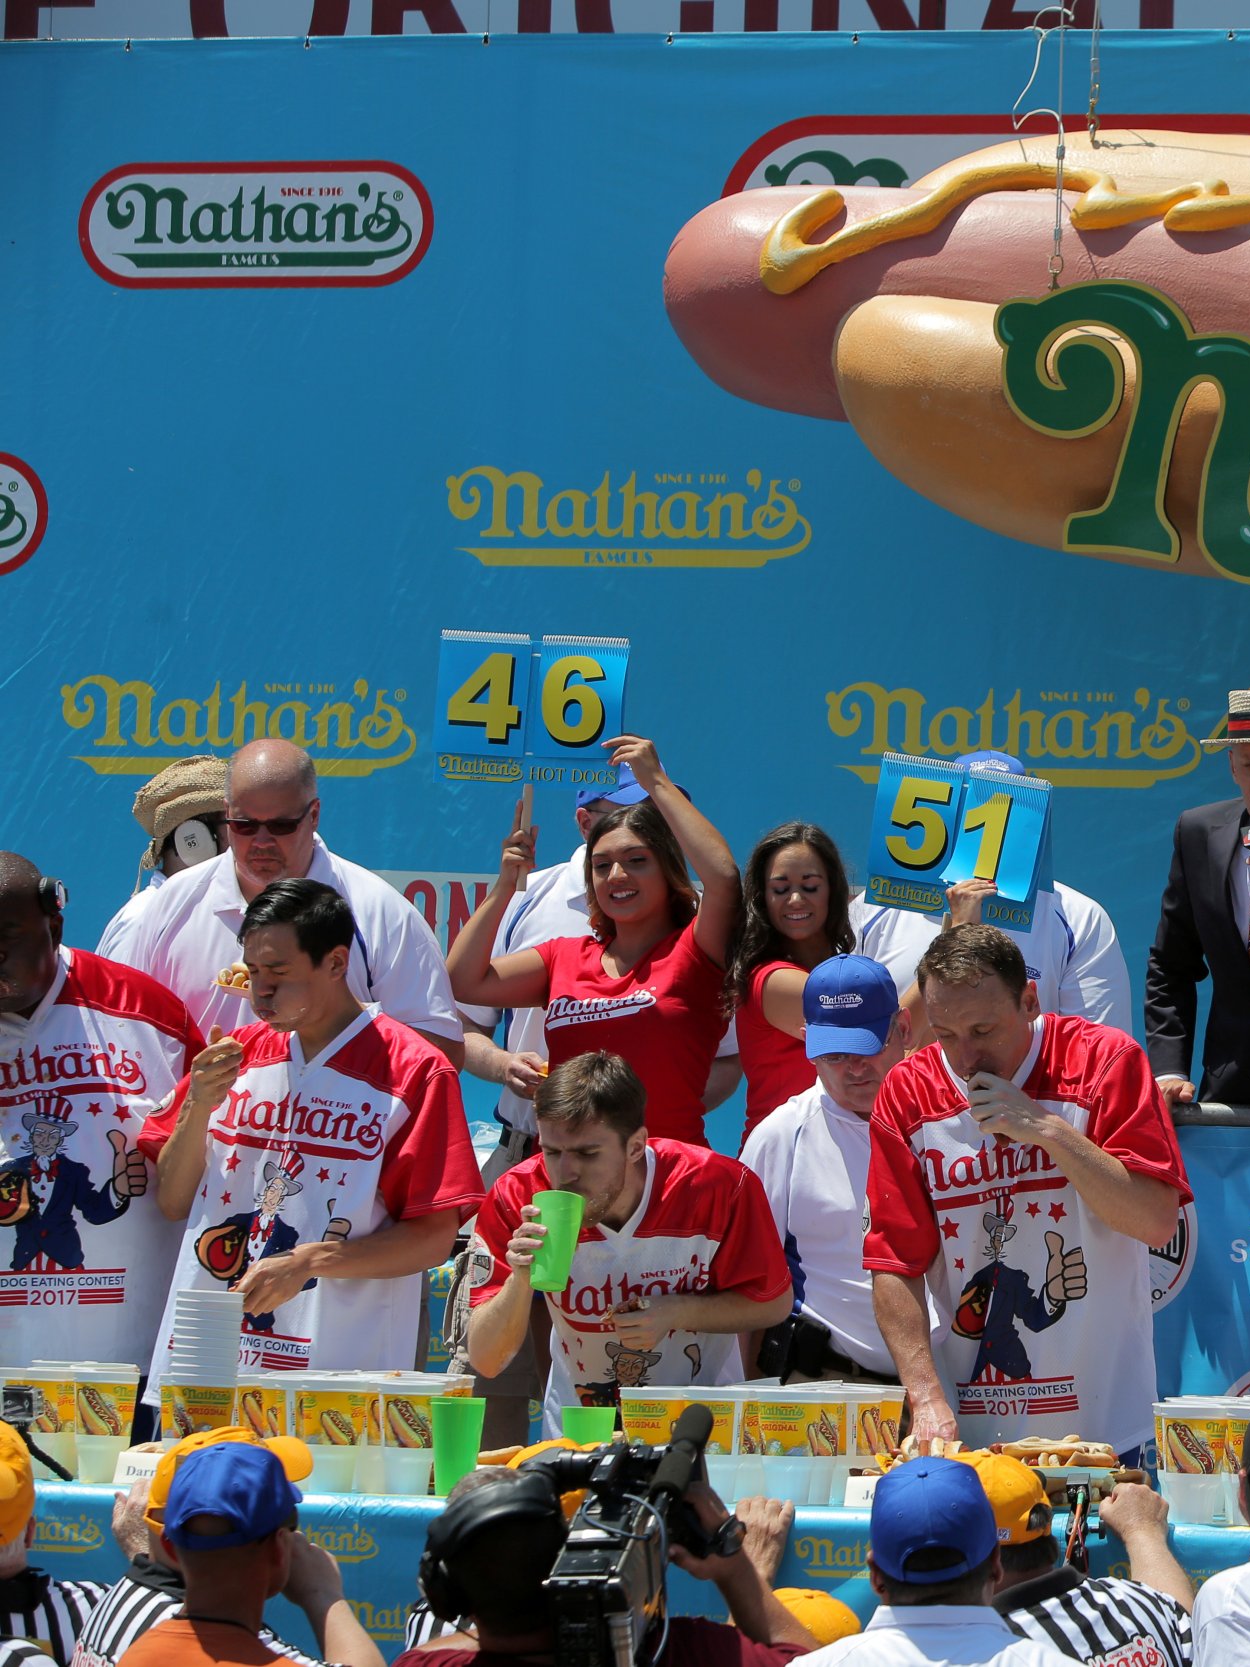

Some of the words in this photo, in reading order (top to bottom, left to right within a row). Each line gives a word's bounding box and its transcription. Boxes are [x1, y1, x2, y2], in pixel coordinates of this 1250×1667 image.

[280, 186, 316, 197] SINCE
[318, 186, 343, 196] 1916
[221, 254, 280, 266] FAMOUS
[654, 472, 693, 485] SINCE
[583, 551, 654, 565] FAMOUS
[264, 682, 301, 694] SINCE
[447, 652, 607, 748] 46
[1040, 690, 1078, 703] SINCE
[529, 766, 567, 781] HOT
[571, 769, 618, 785] DOGS
[884, 776, 1015, 882] 51
[986, 903, 1031, 926] DOGS
[53, 1042, 80, 1052] SINCE
[0, 1042, 141, 1090] athan's
[310, 1096, 334, 1108] SINCE
[0, 1277, 28, 1288] DOG
[31, 1276, 75, 1287] EATING
[78, 1275, 125, 1286] CONTEST
[640, 1270, 666, 1280] SINCE
[30, 1289, 77, 1306] 2017
[264, 1339, 311, 1355] CONTEST
[238, 1350, 262, 1367] 17
[984, 1386, 1025, 1398] EATING
[1027, 1383, 1075, 1396] CONTEST
[986, 1399, 1028, 1416] 2017
